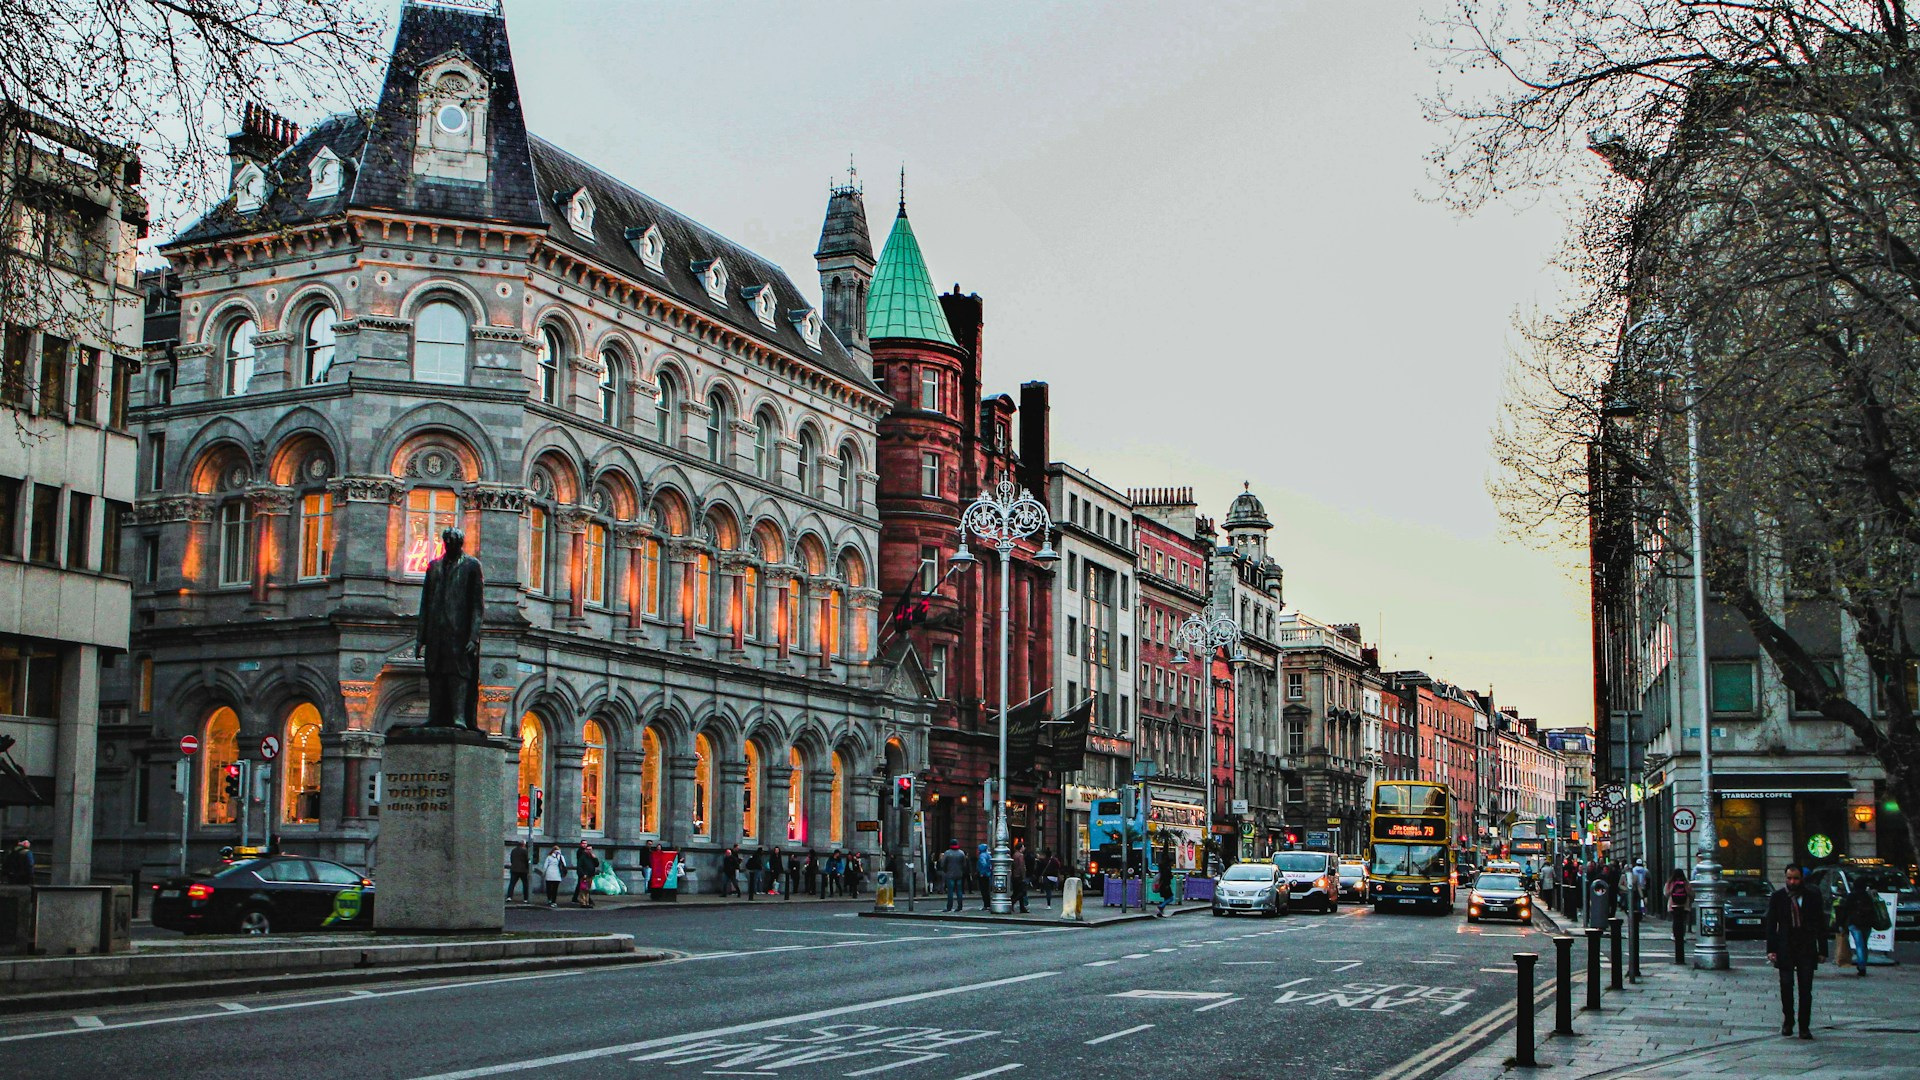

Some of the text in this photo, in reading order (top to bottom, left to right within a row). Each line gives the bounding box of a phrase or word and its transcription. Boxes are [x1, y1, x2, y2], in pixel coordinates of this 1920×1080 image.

[1675, 818, 1692, 826] TAXI
[1424, 826, 1434, 836] 79
[1329, 983, 1476, 1000] BUS
[766, 1024, 1001, 1049] BUS
